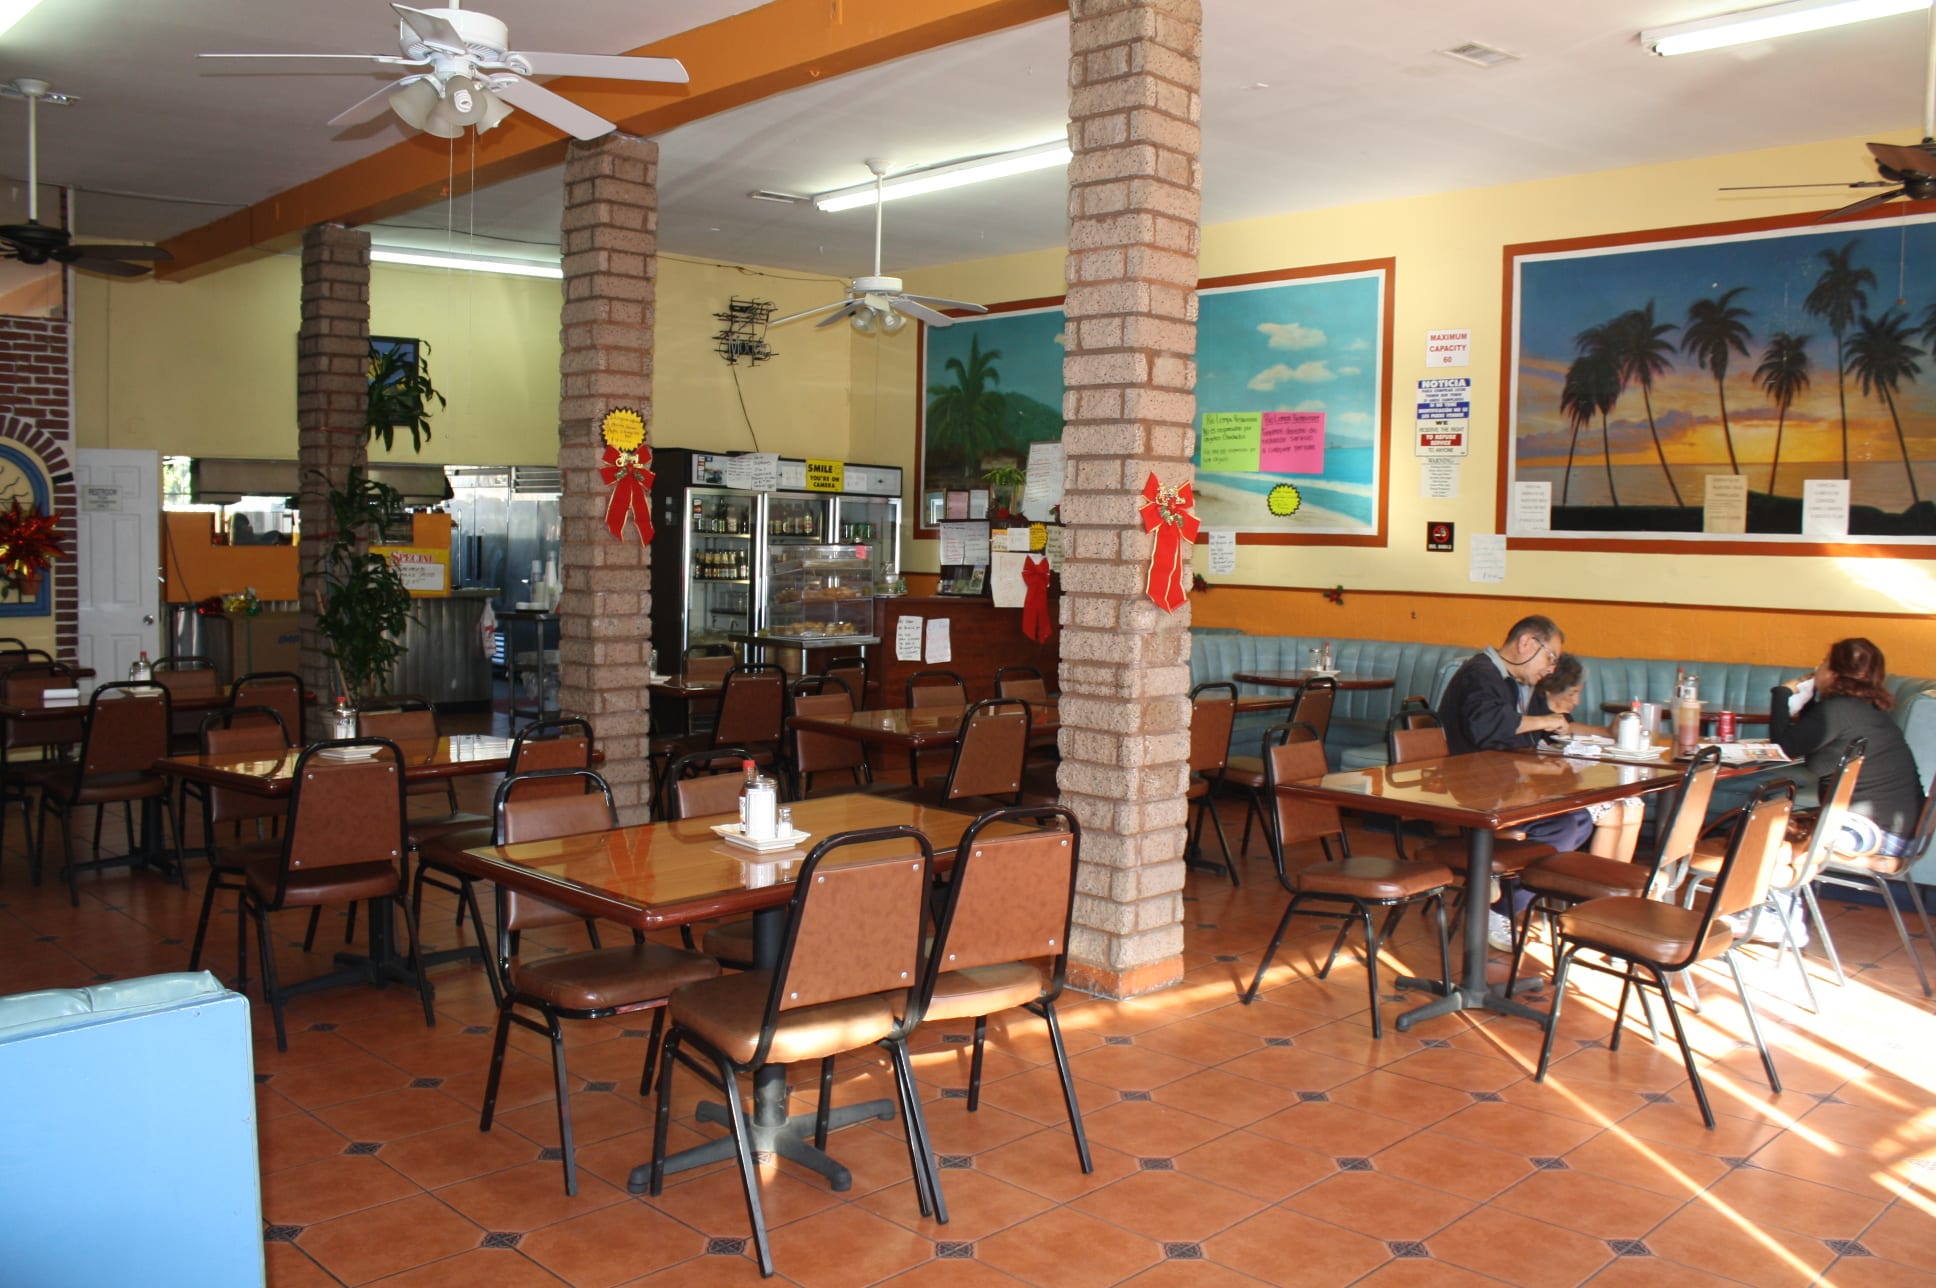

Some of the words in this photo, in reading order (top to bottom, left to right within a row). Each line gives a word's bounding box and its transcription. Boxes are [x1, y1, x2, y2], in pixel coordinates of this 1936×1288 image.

[1430, 333, 1467, 341] MAXIMUM
[1429, 344, 1467, 352] CAPACITY
[1421, 379, 1466, 388] NOTICIA
[808, 464, 833, 473] SMILE
